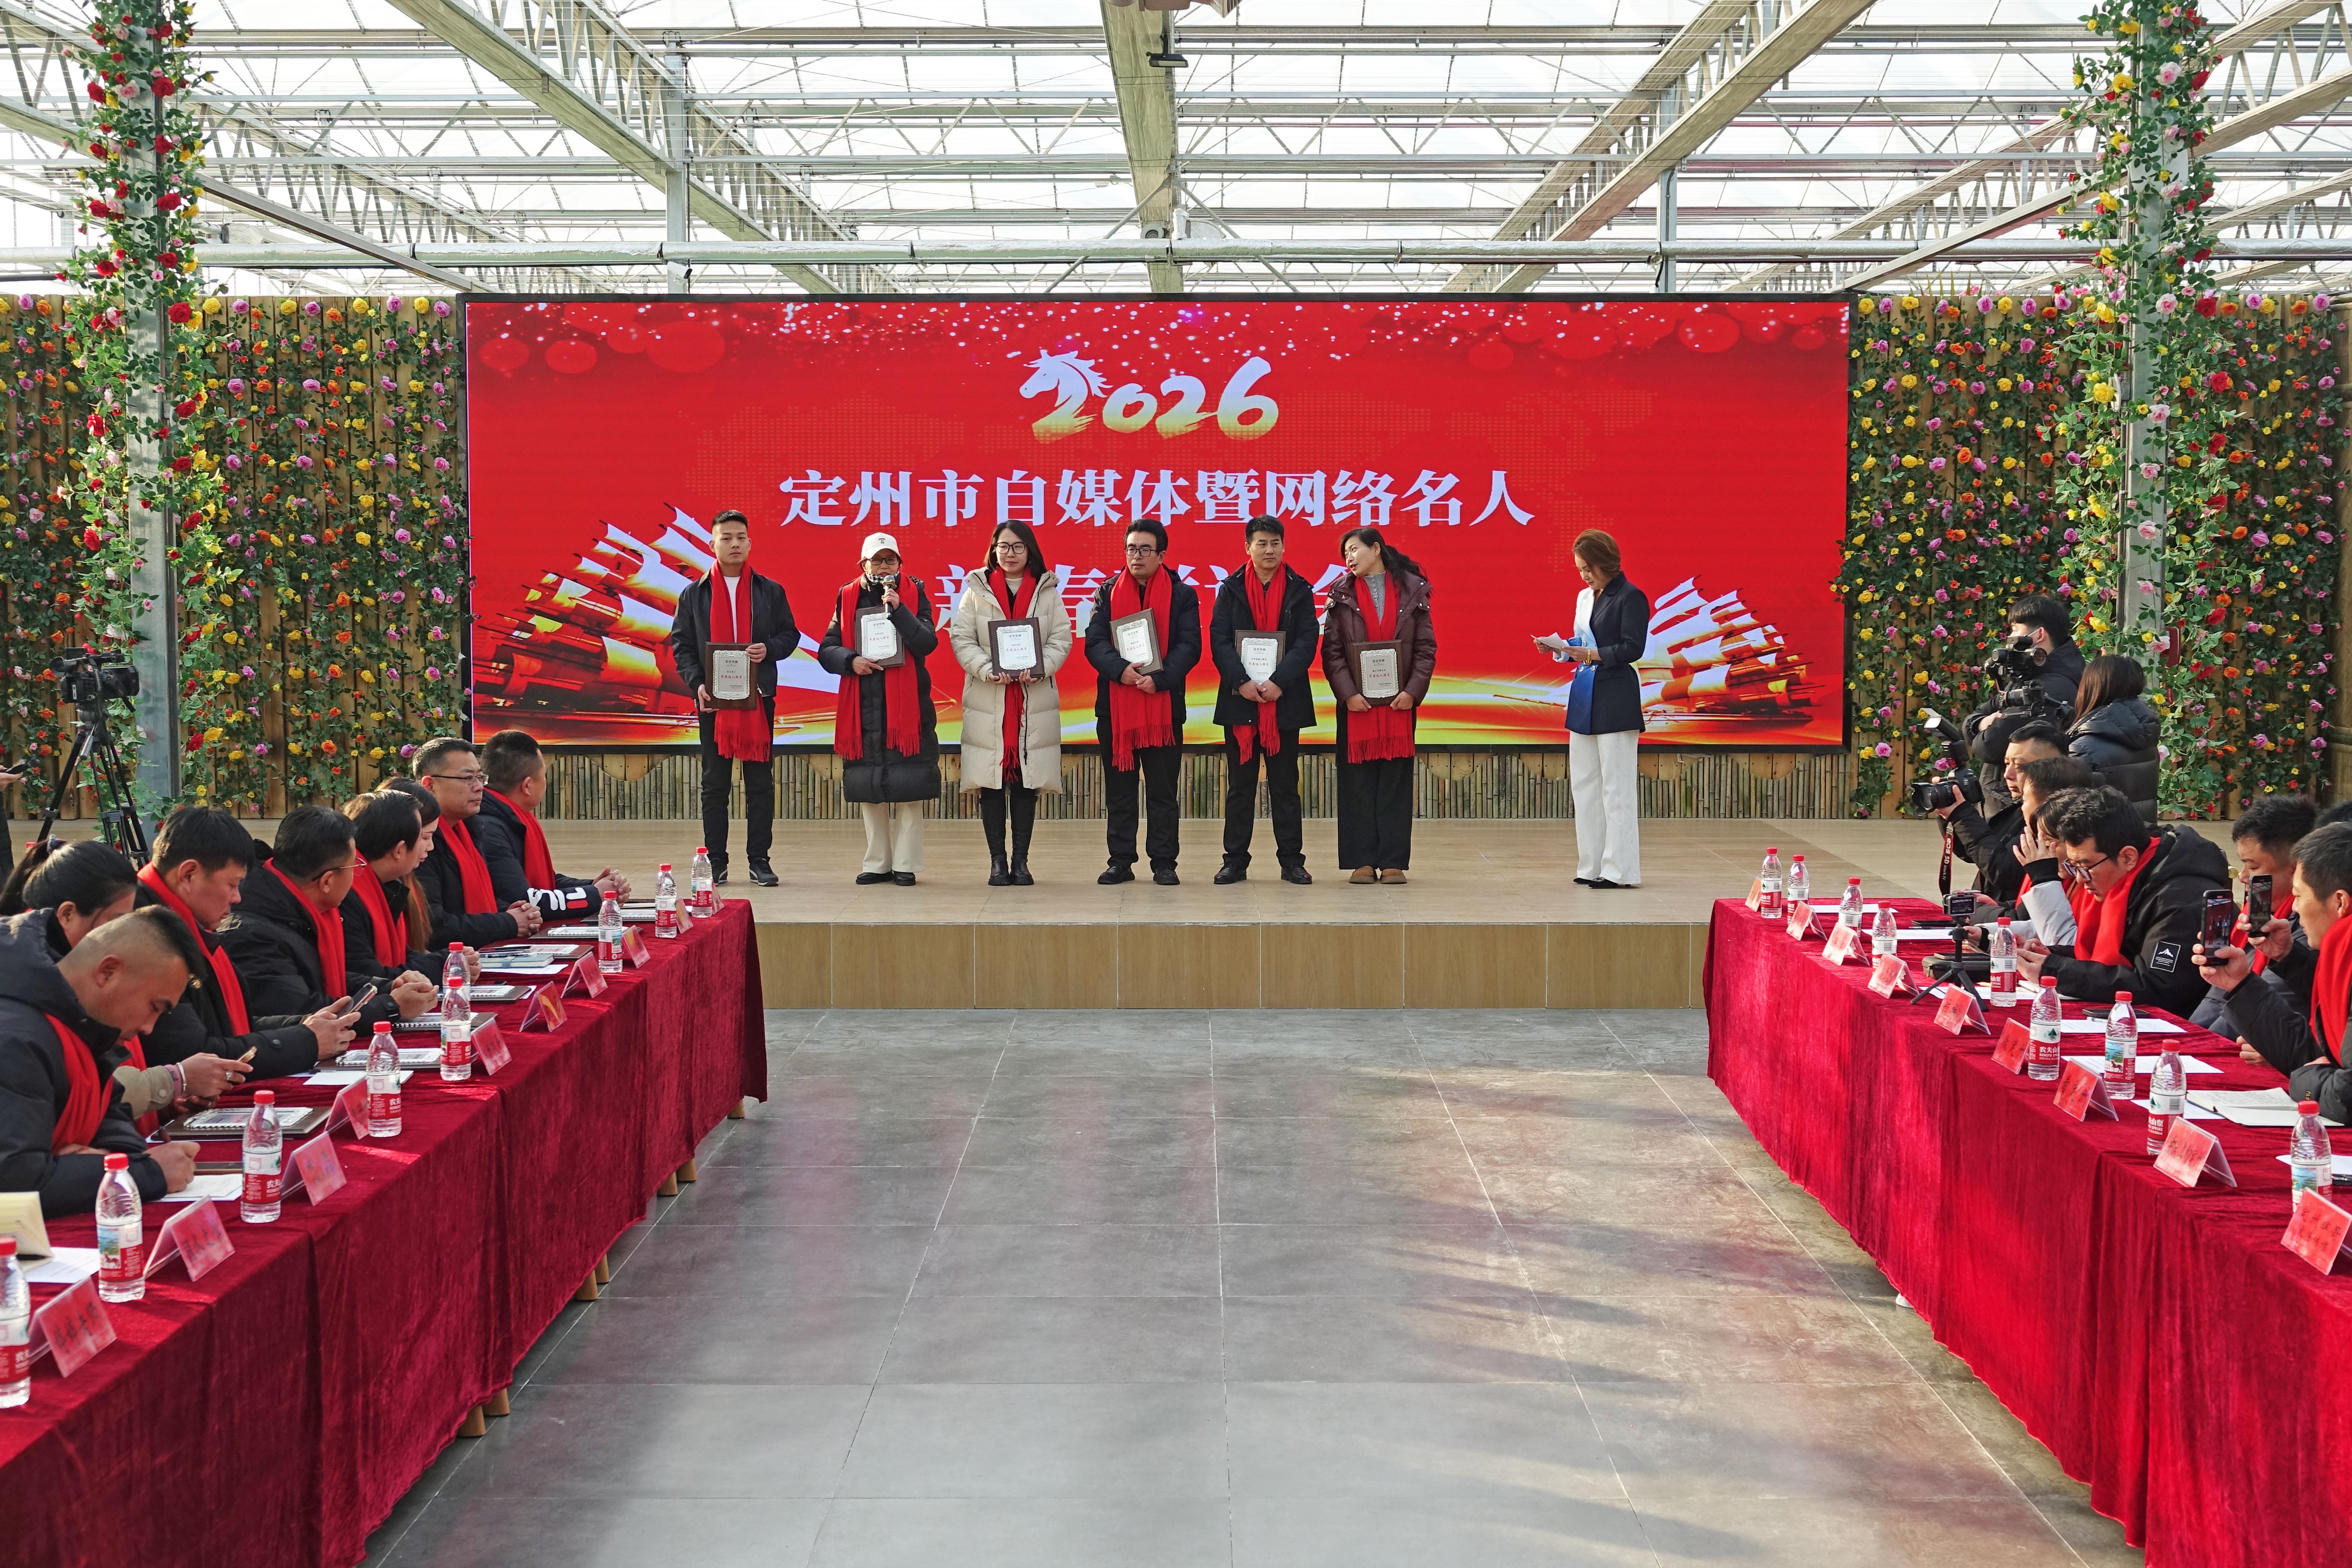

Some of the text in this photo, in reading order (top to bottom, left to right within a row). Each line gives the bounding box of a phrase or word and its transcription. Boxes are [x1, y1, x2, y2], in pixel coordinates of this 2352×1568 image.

[1020, 349, 1279, 443] 2026
[780, 469, 1536, 527] 定州市自媒体暨网络名人
[1944, 855, 1950, 864] 5D
[527, 888, 588, 911] FILA
